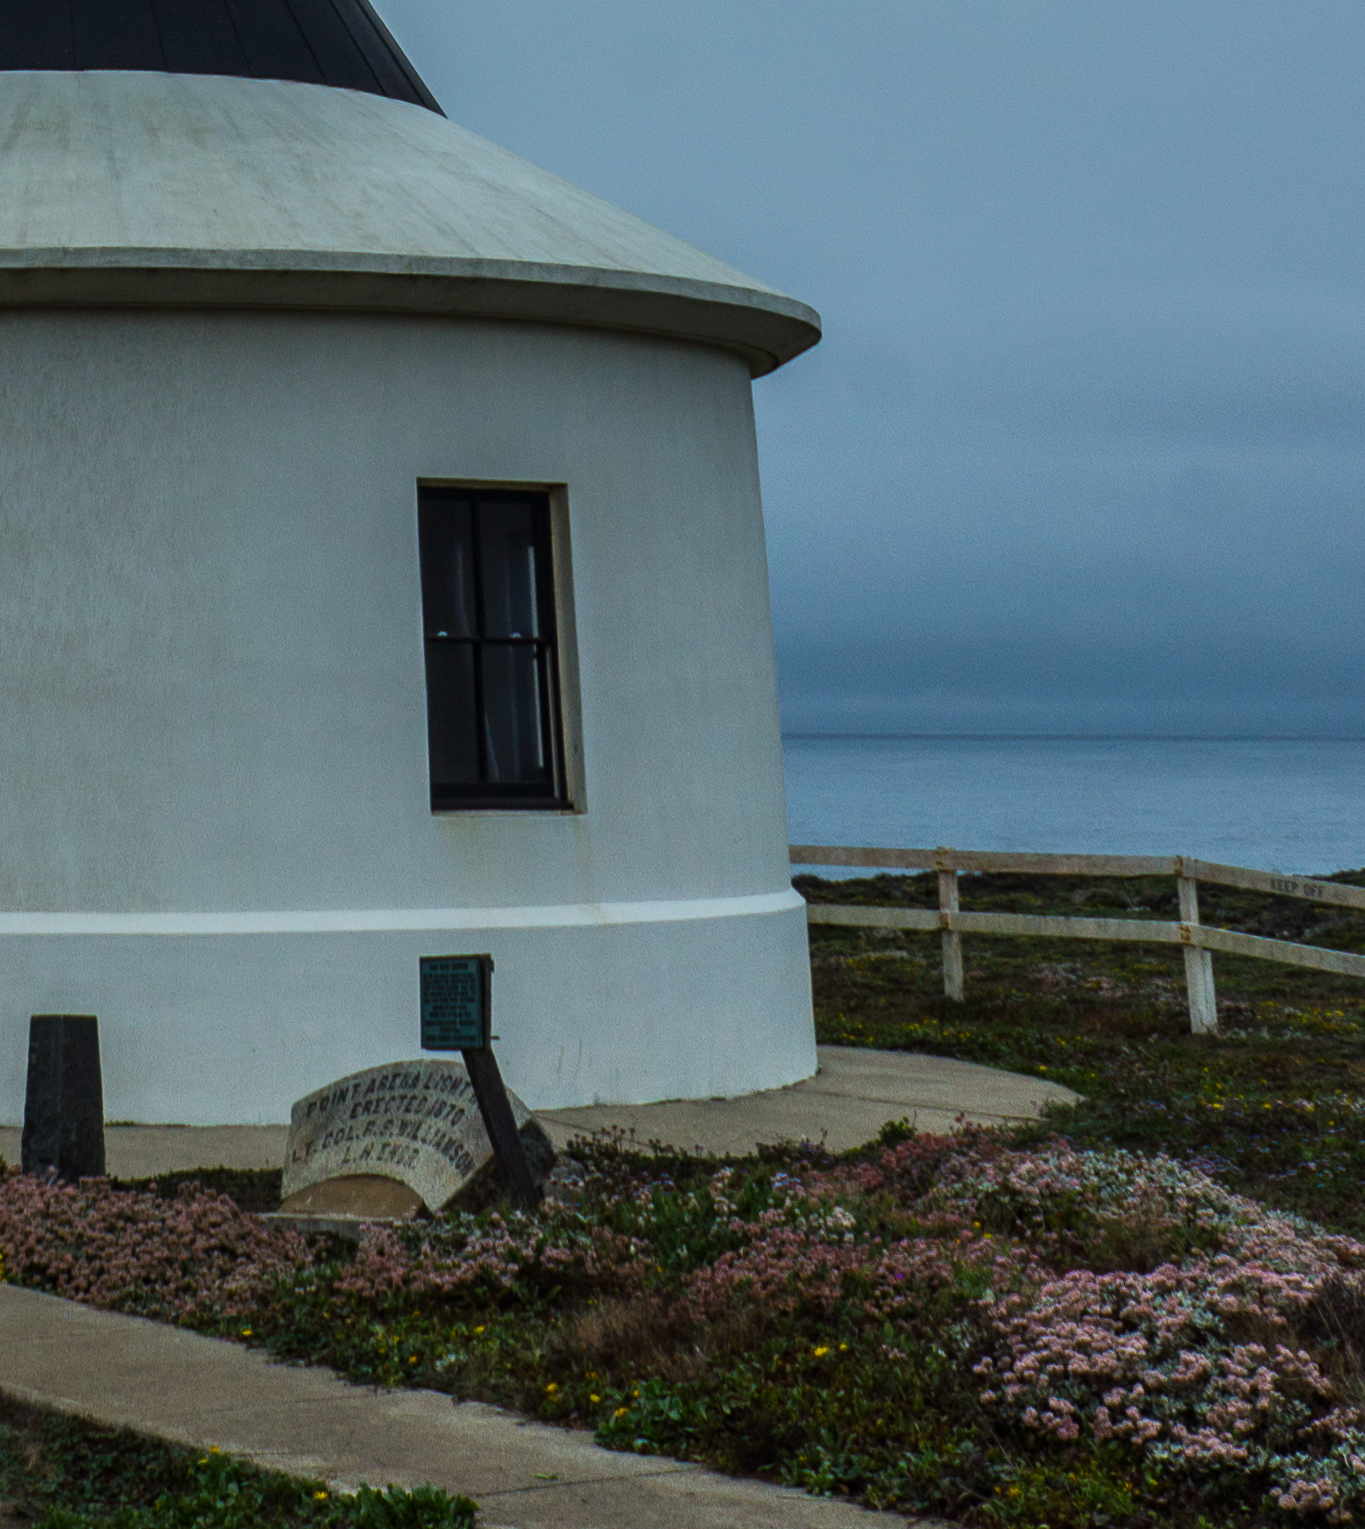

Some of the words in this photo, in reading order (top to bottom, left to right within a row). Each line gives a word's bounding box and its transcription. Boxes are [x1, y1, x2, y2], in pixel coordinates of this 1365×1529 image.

[1270, 879, 1299, 893] KEEP
[1303, 883, 1326, 898] OFF
[306, 1082, 362, 1119] POINT
[363, 1072, 422, 1097] ARENA
[349, 1094, 428, 1119] ERECTED
[425, 1097, 466, 1127] 1870
[396, 1118, 477, 1178] WILLIAMSON
